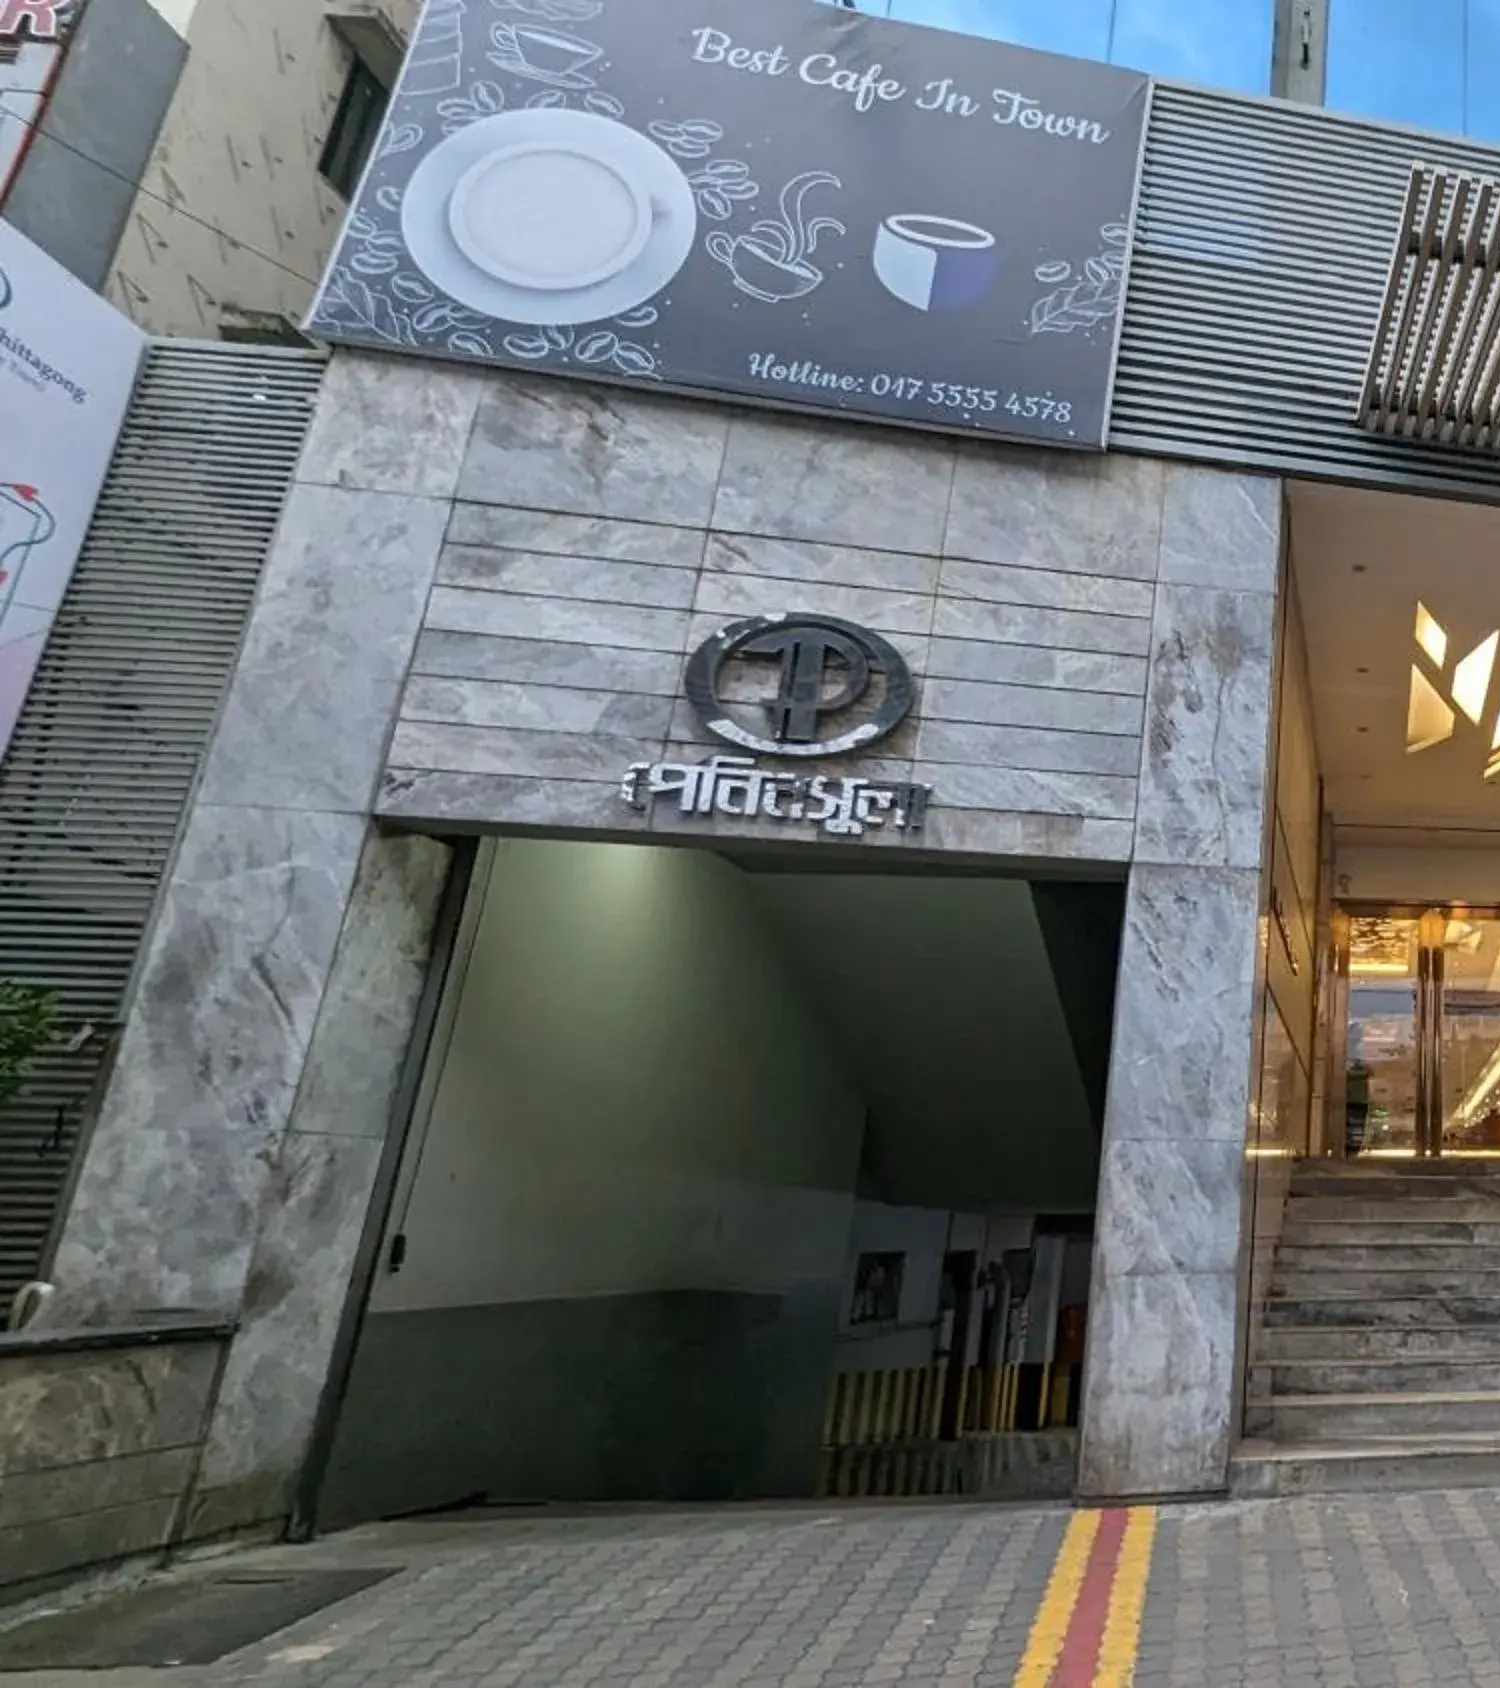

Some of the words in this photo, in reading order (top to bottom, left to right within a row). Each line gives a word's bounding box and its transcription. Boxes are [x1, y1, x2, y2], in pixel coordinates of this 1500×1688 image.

[691, 26, 791, 75] Best
[799, 53, 907, 112] Cafe
[915, 78, 980, 117] In
[991, 87, 1113, 144] Town
[0, 326, 88, 405] hittagong
[749, 352, 864, 393] Hotline:
[870, 373, 924, 401] 017
[926, 382, 998, 412] 5555
[1003, 392, 1073, 424] 4578
